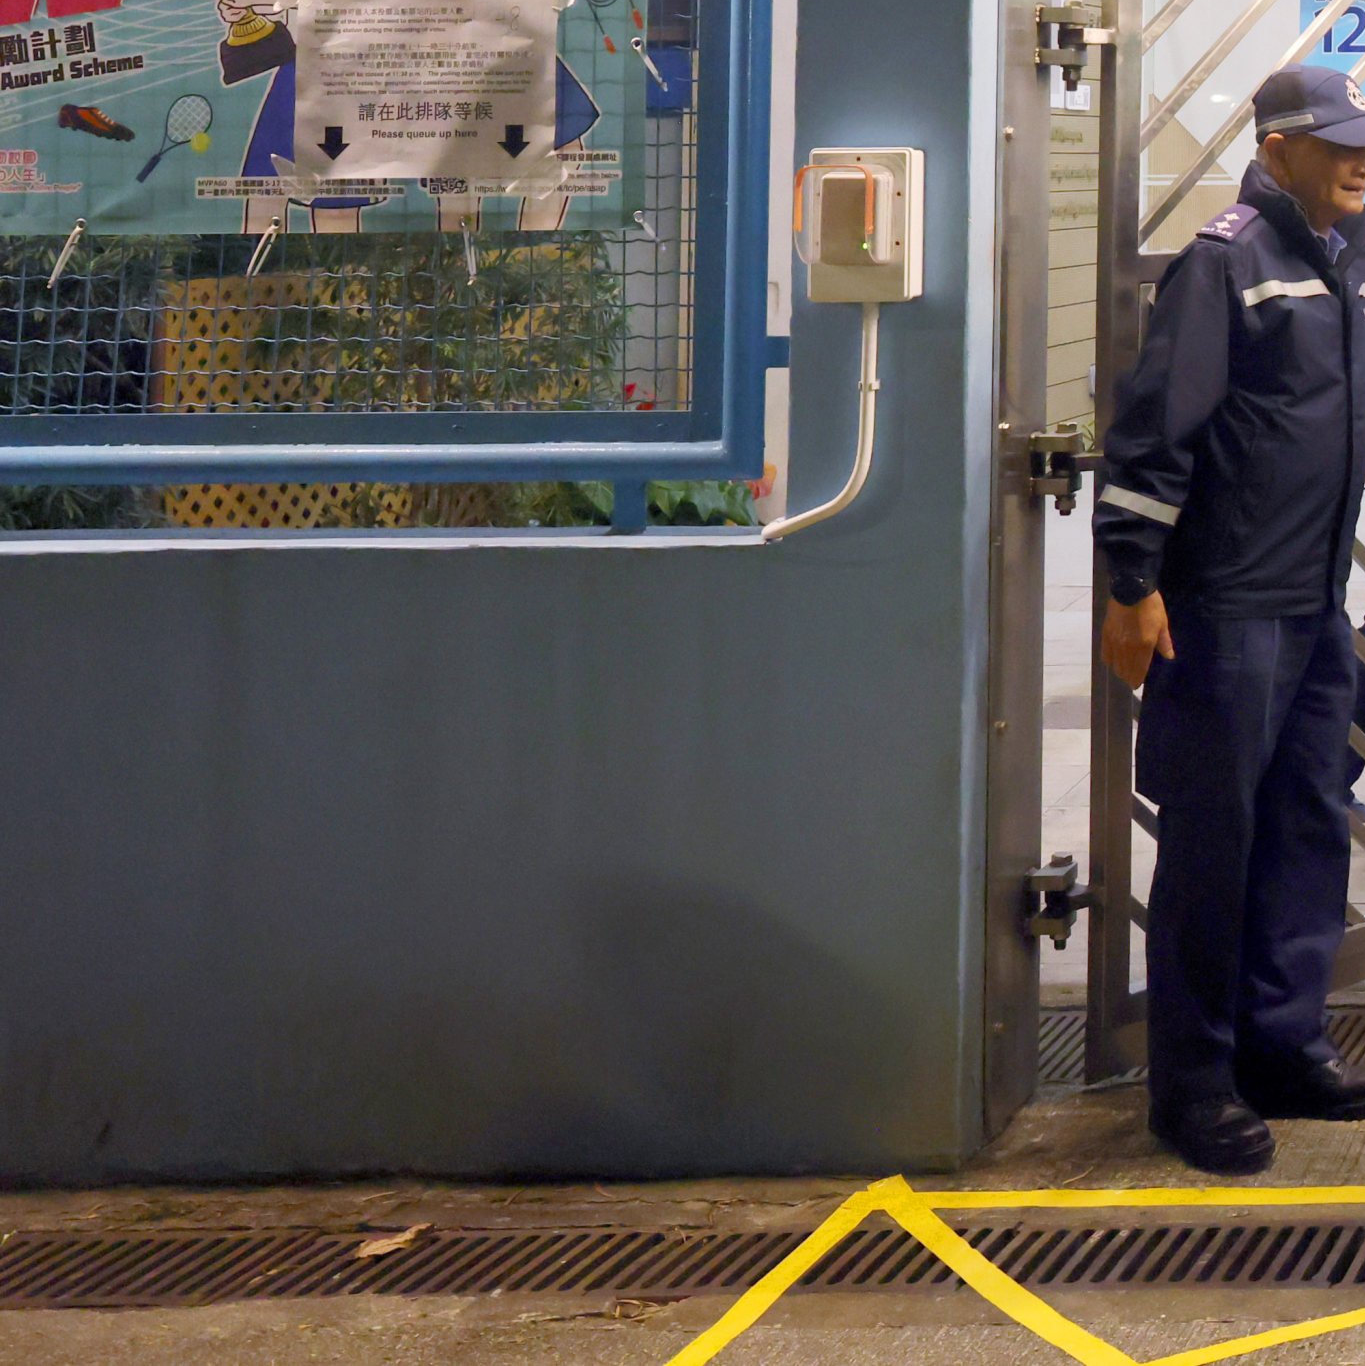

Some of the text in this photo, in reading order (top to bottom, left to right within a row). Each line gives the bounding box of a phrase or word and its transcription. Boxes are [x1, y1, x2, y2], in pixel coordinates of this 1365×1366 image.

[1, 55, 144, 90] Award Scheme
[359, 102, 494, 122] 請在此排隊等候
[372, 129, 478, 139] Please queue up here
